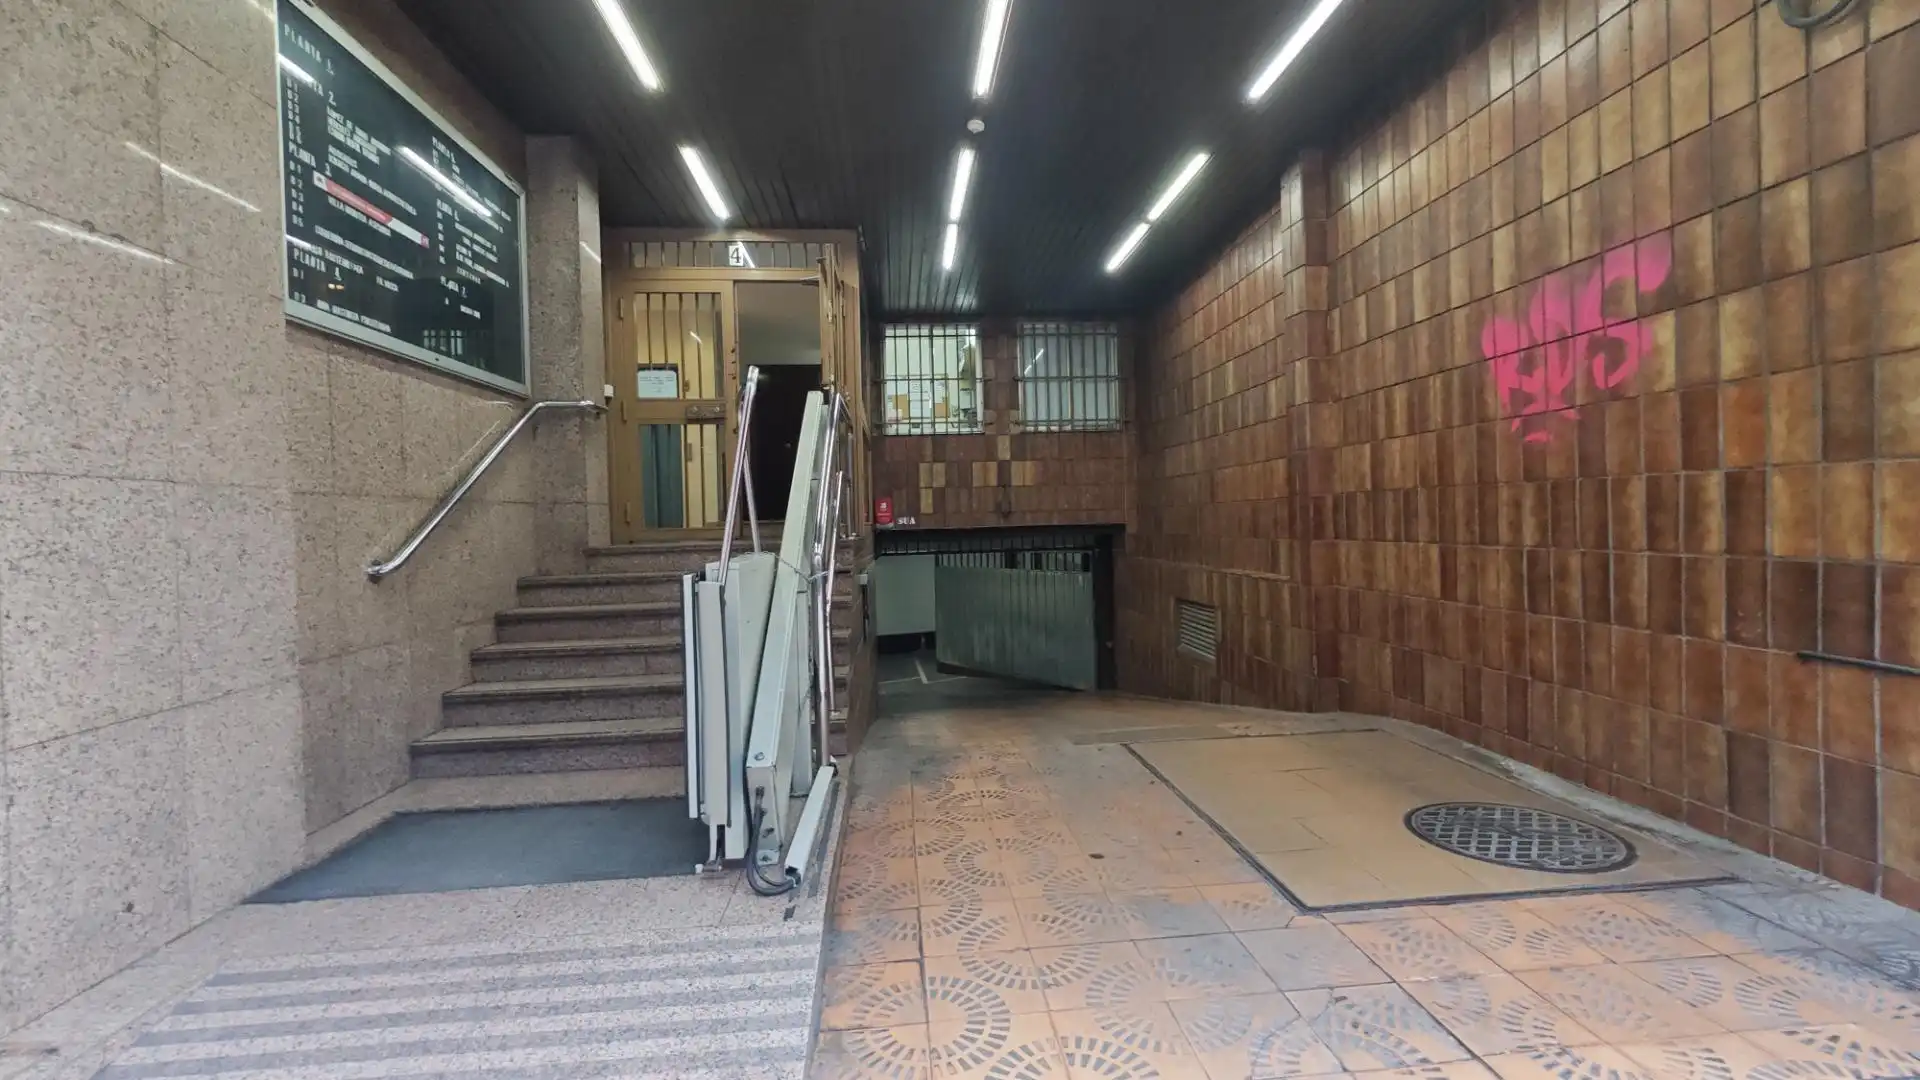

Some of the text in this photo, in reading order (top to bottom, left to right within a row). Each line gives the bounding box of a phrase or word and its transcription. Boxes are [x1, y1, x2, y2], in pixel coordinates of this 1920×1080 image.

[284, 24, 322, 63] PLANTA
[293, 247, 326, 273] PLANTA
[731, 247, 741, 264] 4
